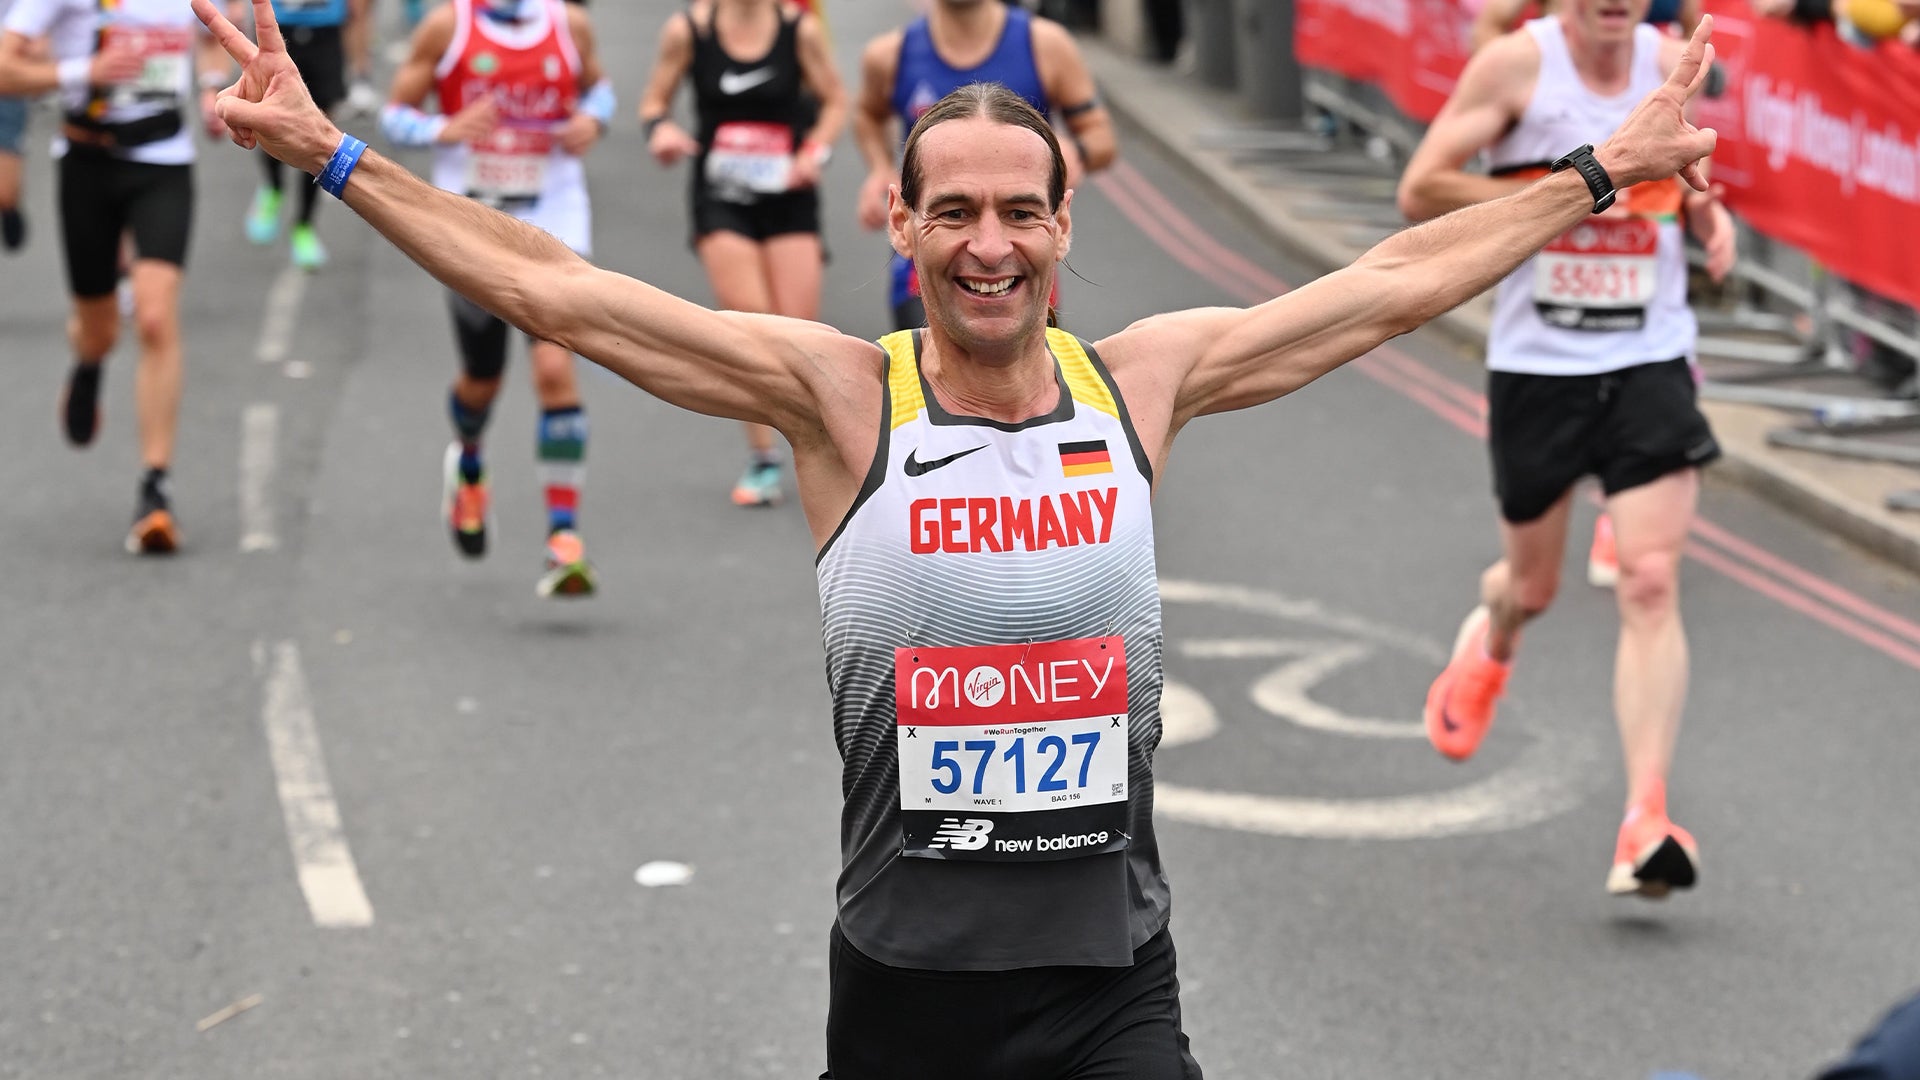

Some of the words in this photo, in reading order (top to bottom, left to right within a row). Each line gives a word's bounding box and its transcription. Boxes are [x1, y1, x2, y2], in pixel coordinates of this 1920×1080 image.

[910, 487, 1118, 555] GERMANY
[968, 671, 1001, 701] Virgin
[983, 726, 1047, 735] #WeRunTogether
[931, 731, 1101, 795] 57127
[973, 798, 996, 806] WAVE
[1051, 794, 1067, 803] BAG
[1069, 792, 1081, 801] 156
[928, 818, 995, 850] NB
[995, 836, 1033, 852] new
[1037, 828, 1109, 852] balance
